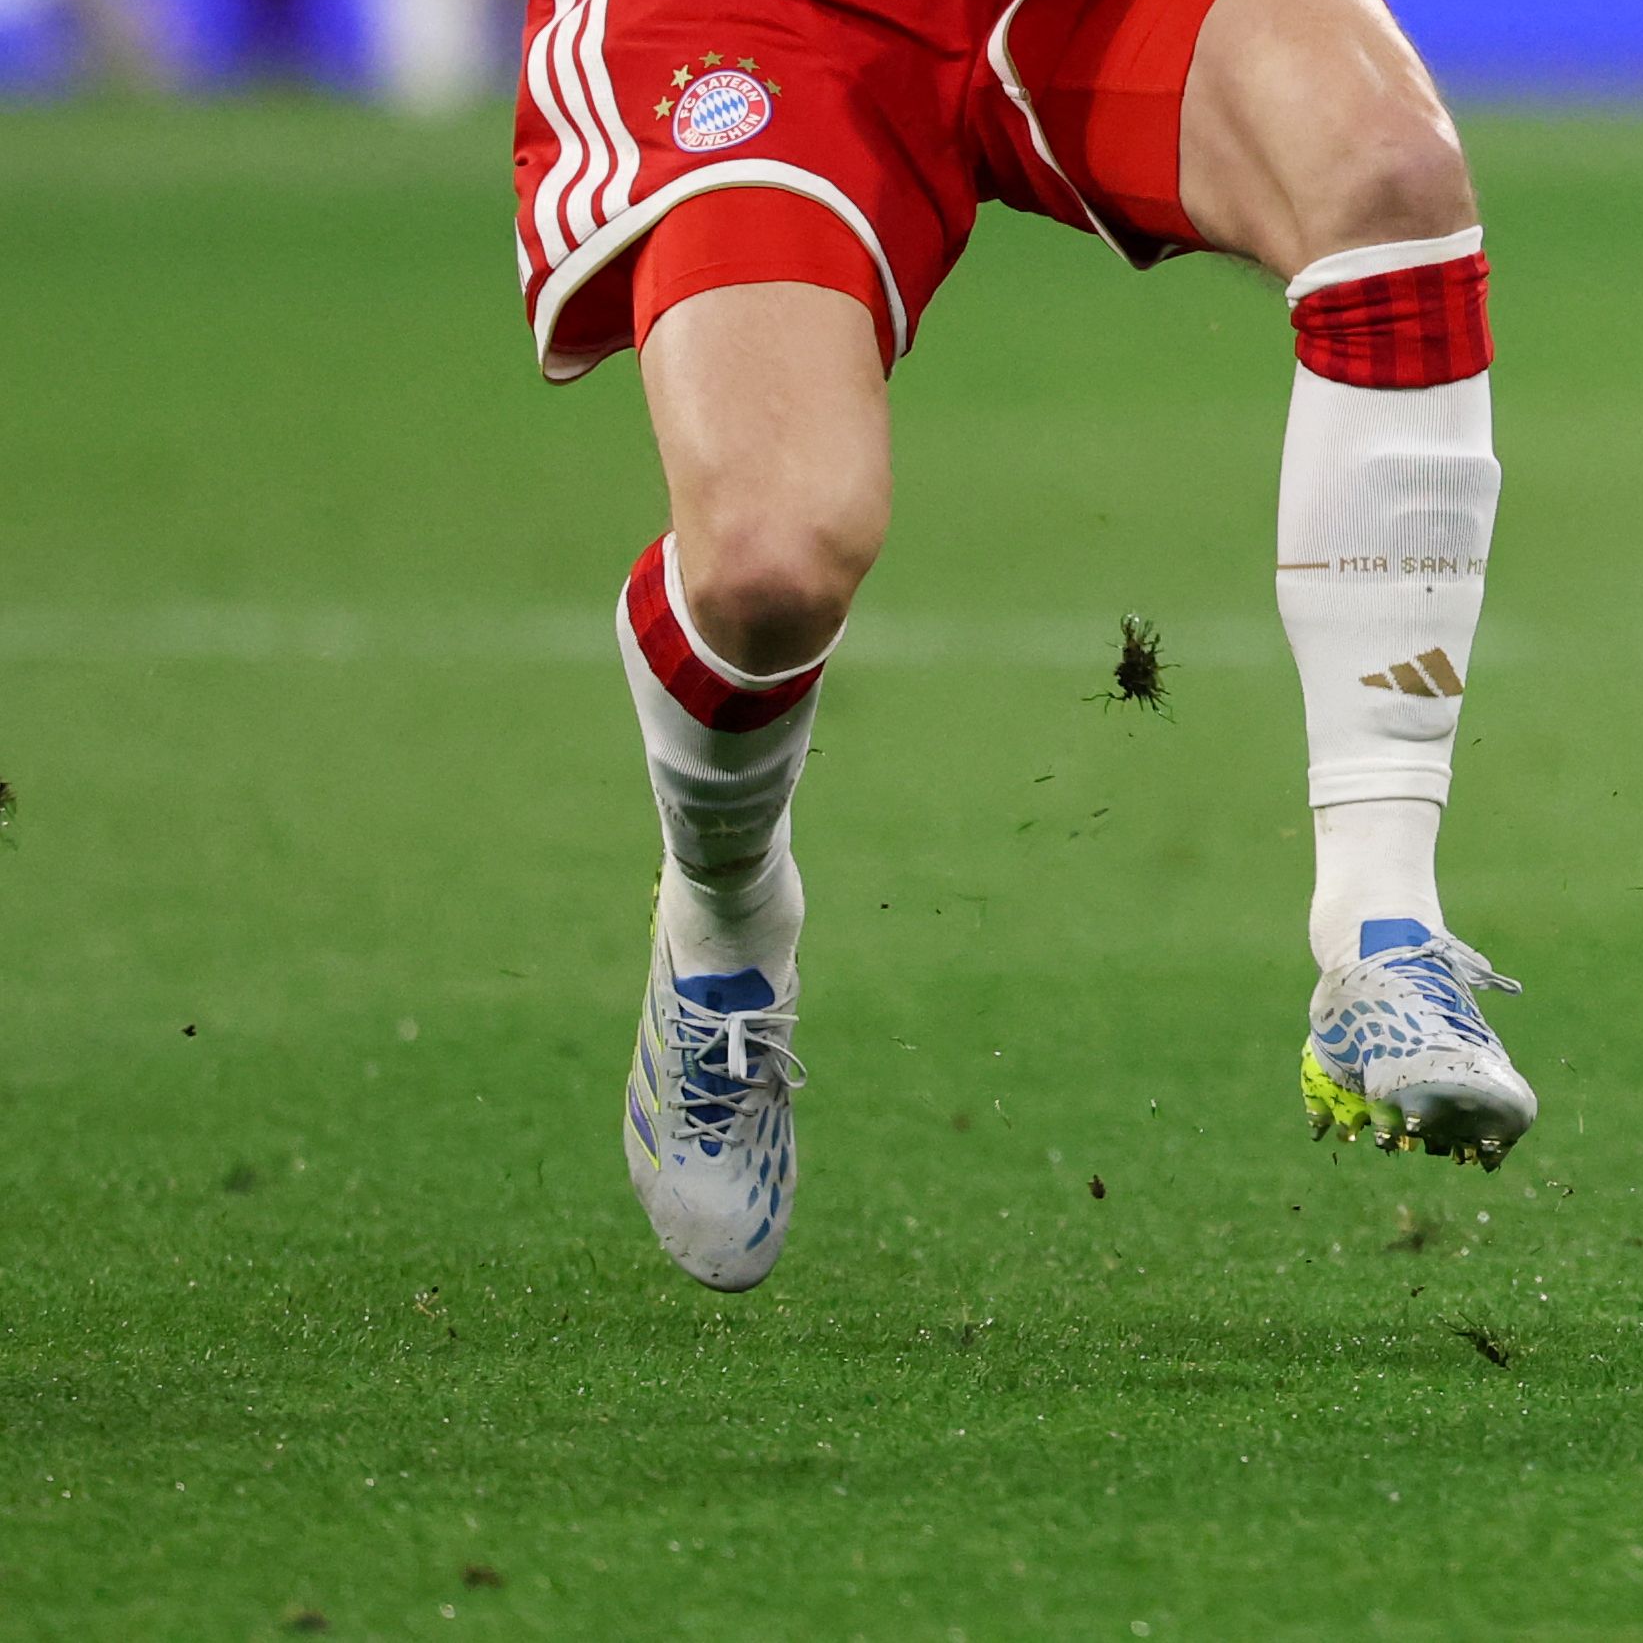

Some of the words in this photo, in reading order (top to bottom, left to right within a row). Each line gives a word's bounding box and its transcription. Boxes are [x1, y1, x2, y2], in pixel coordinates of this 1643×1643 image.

[680, 97, 696, 118] FC
[695, 76, 761, 102] BAYERN
[1339, 556, 1388, 574] MIA
[1401, 556, 1457, 574] SAN
